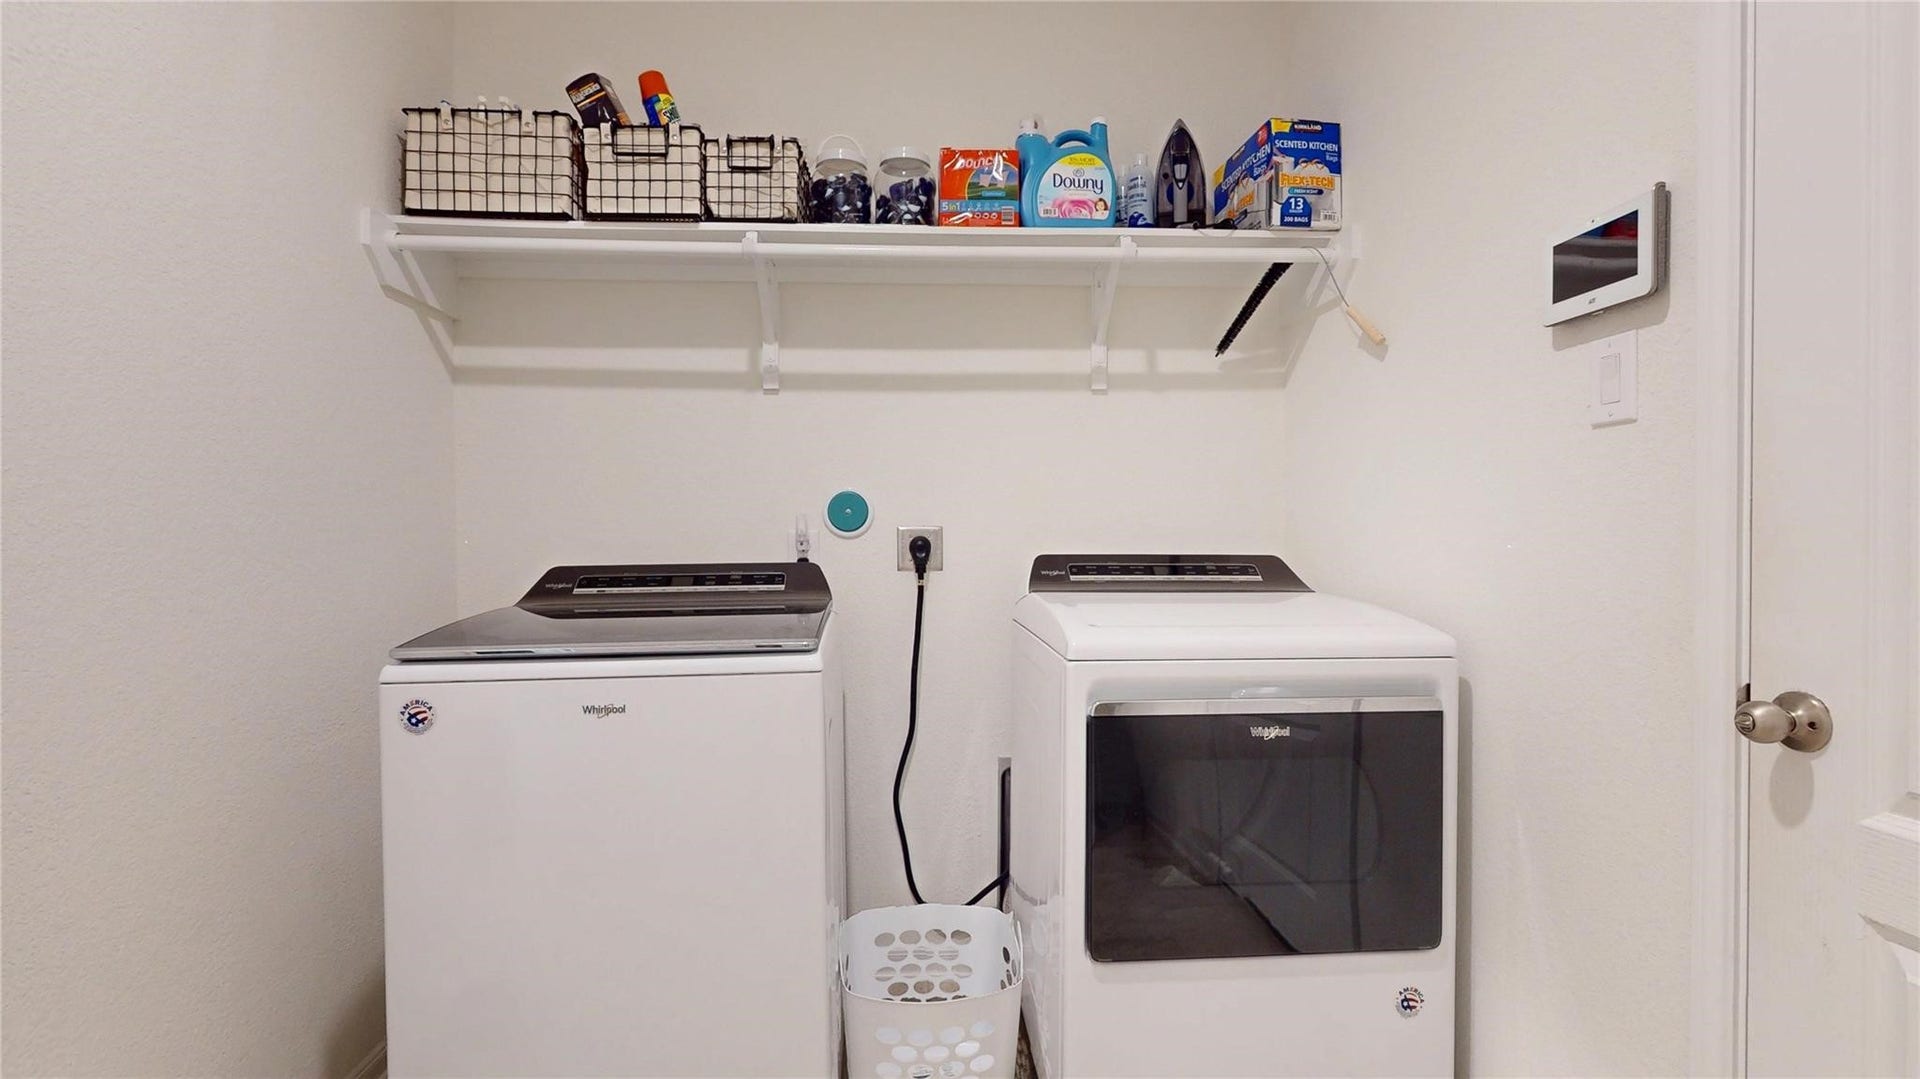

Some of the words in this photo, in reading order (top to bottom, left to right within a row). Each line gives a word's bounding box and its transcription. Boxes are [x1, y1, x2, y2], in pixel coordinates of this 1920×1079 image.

[1274, 139, 1308, 149] SCENTED
[1309, 141, 1338, 152] KITCHEN
[1242, 142, 1271, 170] KITCHEN
[1053, 173, 1103, 195] Downy
[1289, 197, 1304, 209] 13
[400, 699, 433, 716] AMERICA
[582, 704, 626, 718] Whirlpool
[1250, 726, 1290, 740] Whirlpool
